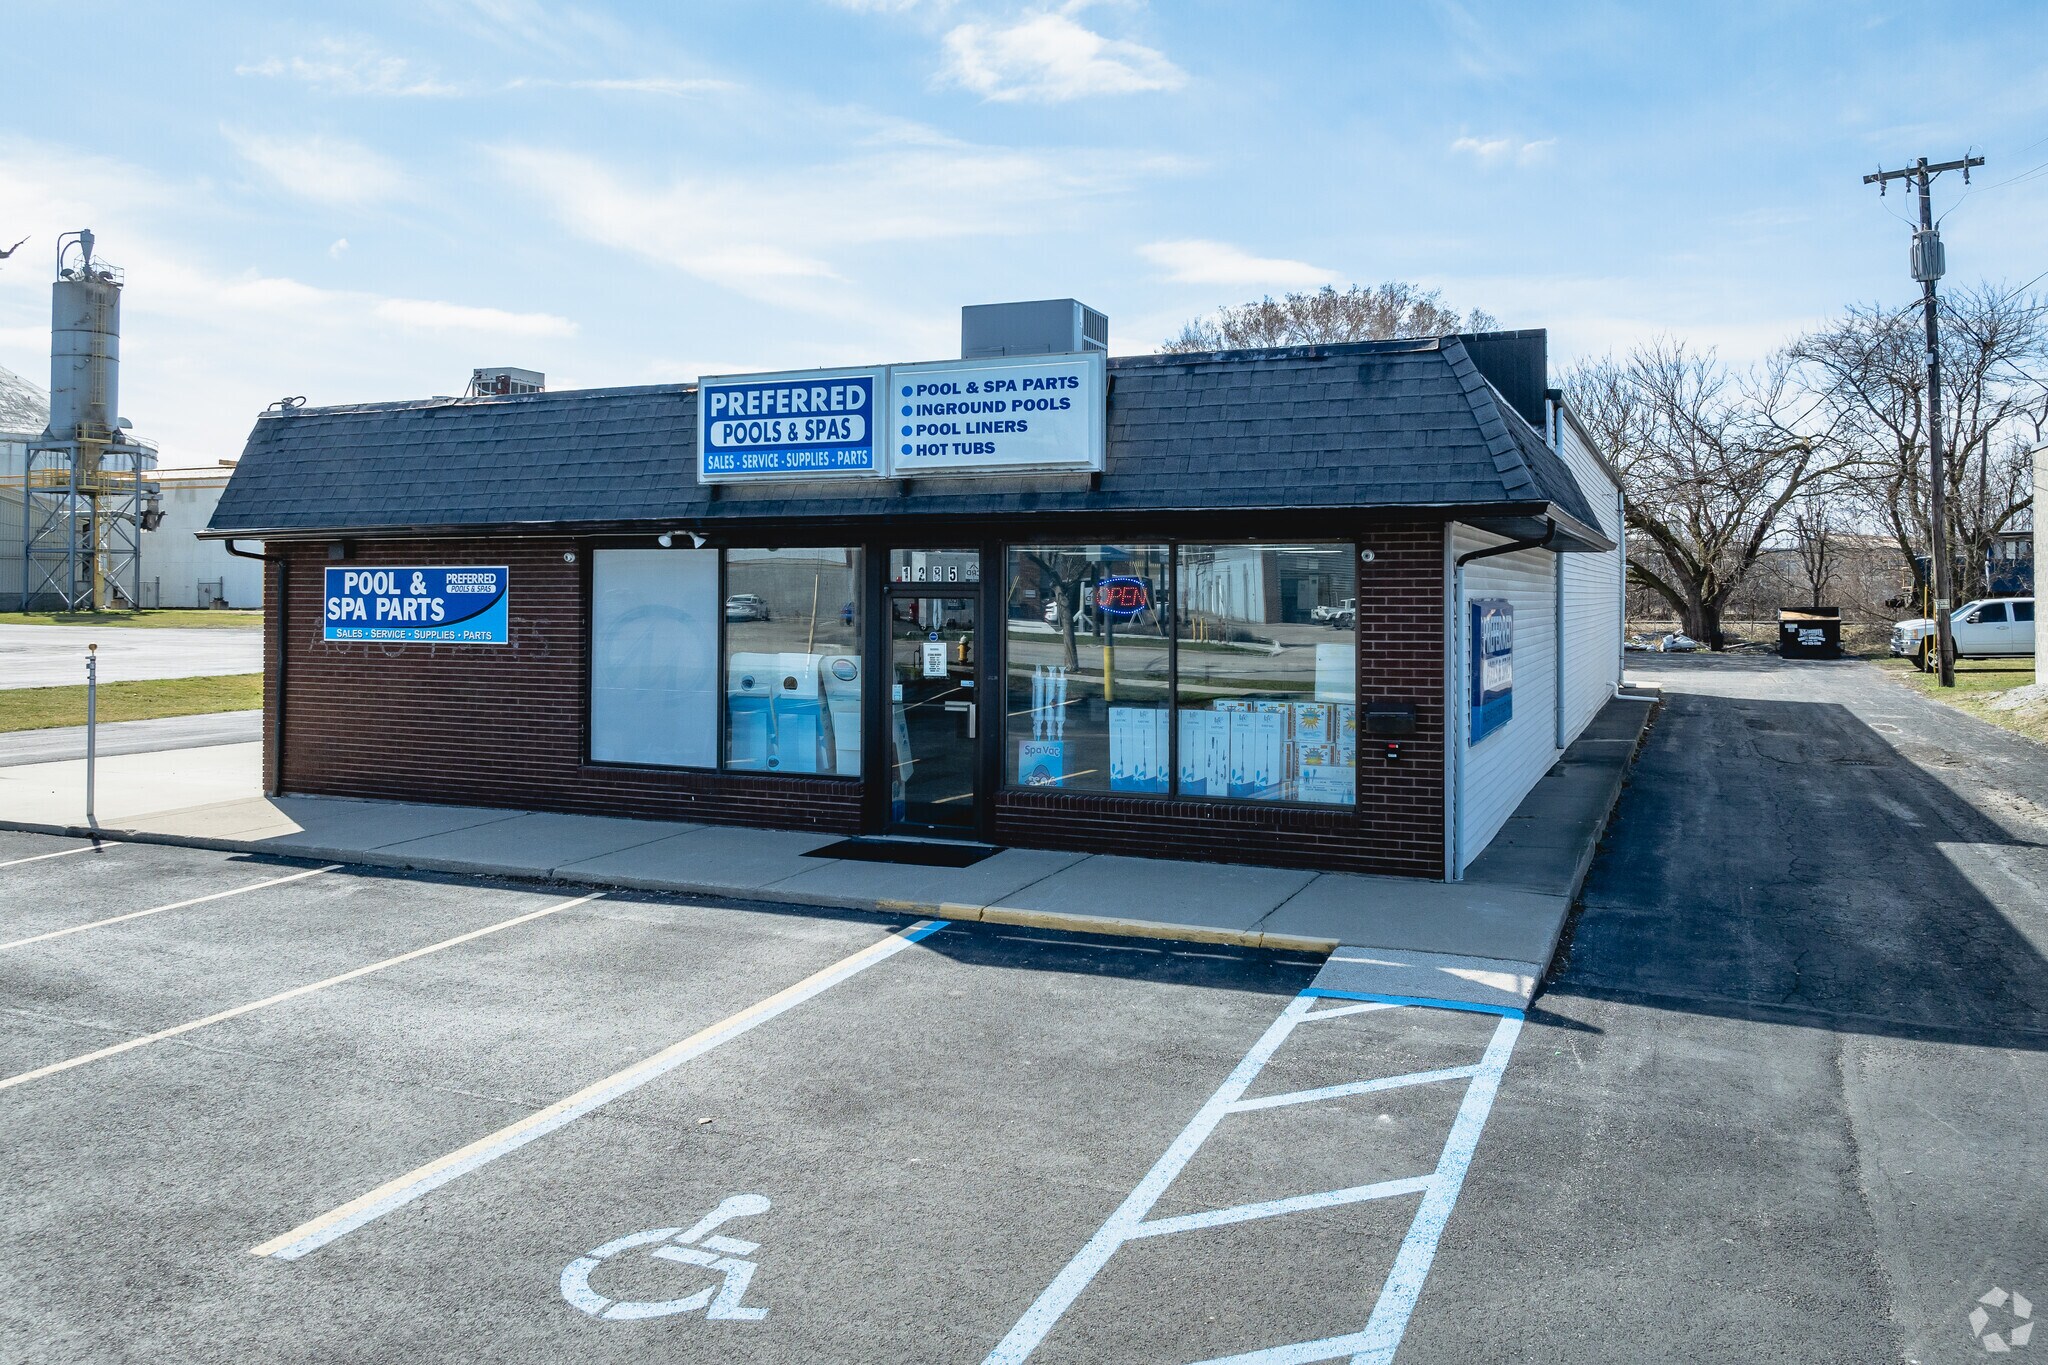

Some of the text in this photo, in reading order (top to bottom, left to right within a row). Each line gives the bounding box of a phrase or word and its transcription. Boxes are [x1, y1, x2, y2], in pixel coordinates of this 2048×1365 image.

[916, 376, 1079, 397] POOL & SPA PARTS
[710, 384, 867, 417] PREFERRED
[916, 397, 1071, 416] INGROUND POOLS
[723, 417, 851, 444] POOLS & SPAS
[916, 420, 1028, 436] POOL LINERS
[916, 441, 996, 456] HOT TUBS
[708, 449, 868, 470] SALES SERVICE SUPPLIES PARTS
[344, 571, 427, 595] POOL &
[446, 573, 497, 584] PREFERRED
[451, 585, 470, 593] POOLS
[1096, 586, 1147, 606] OPEN
[327, 597, 445, 621] SPA PARTS
[336, 628, 492, 640] SALES SERVICE SUPPLIES PARTS
[1024, 745, 1060, 757] Spa Vac
